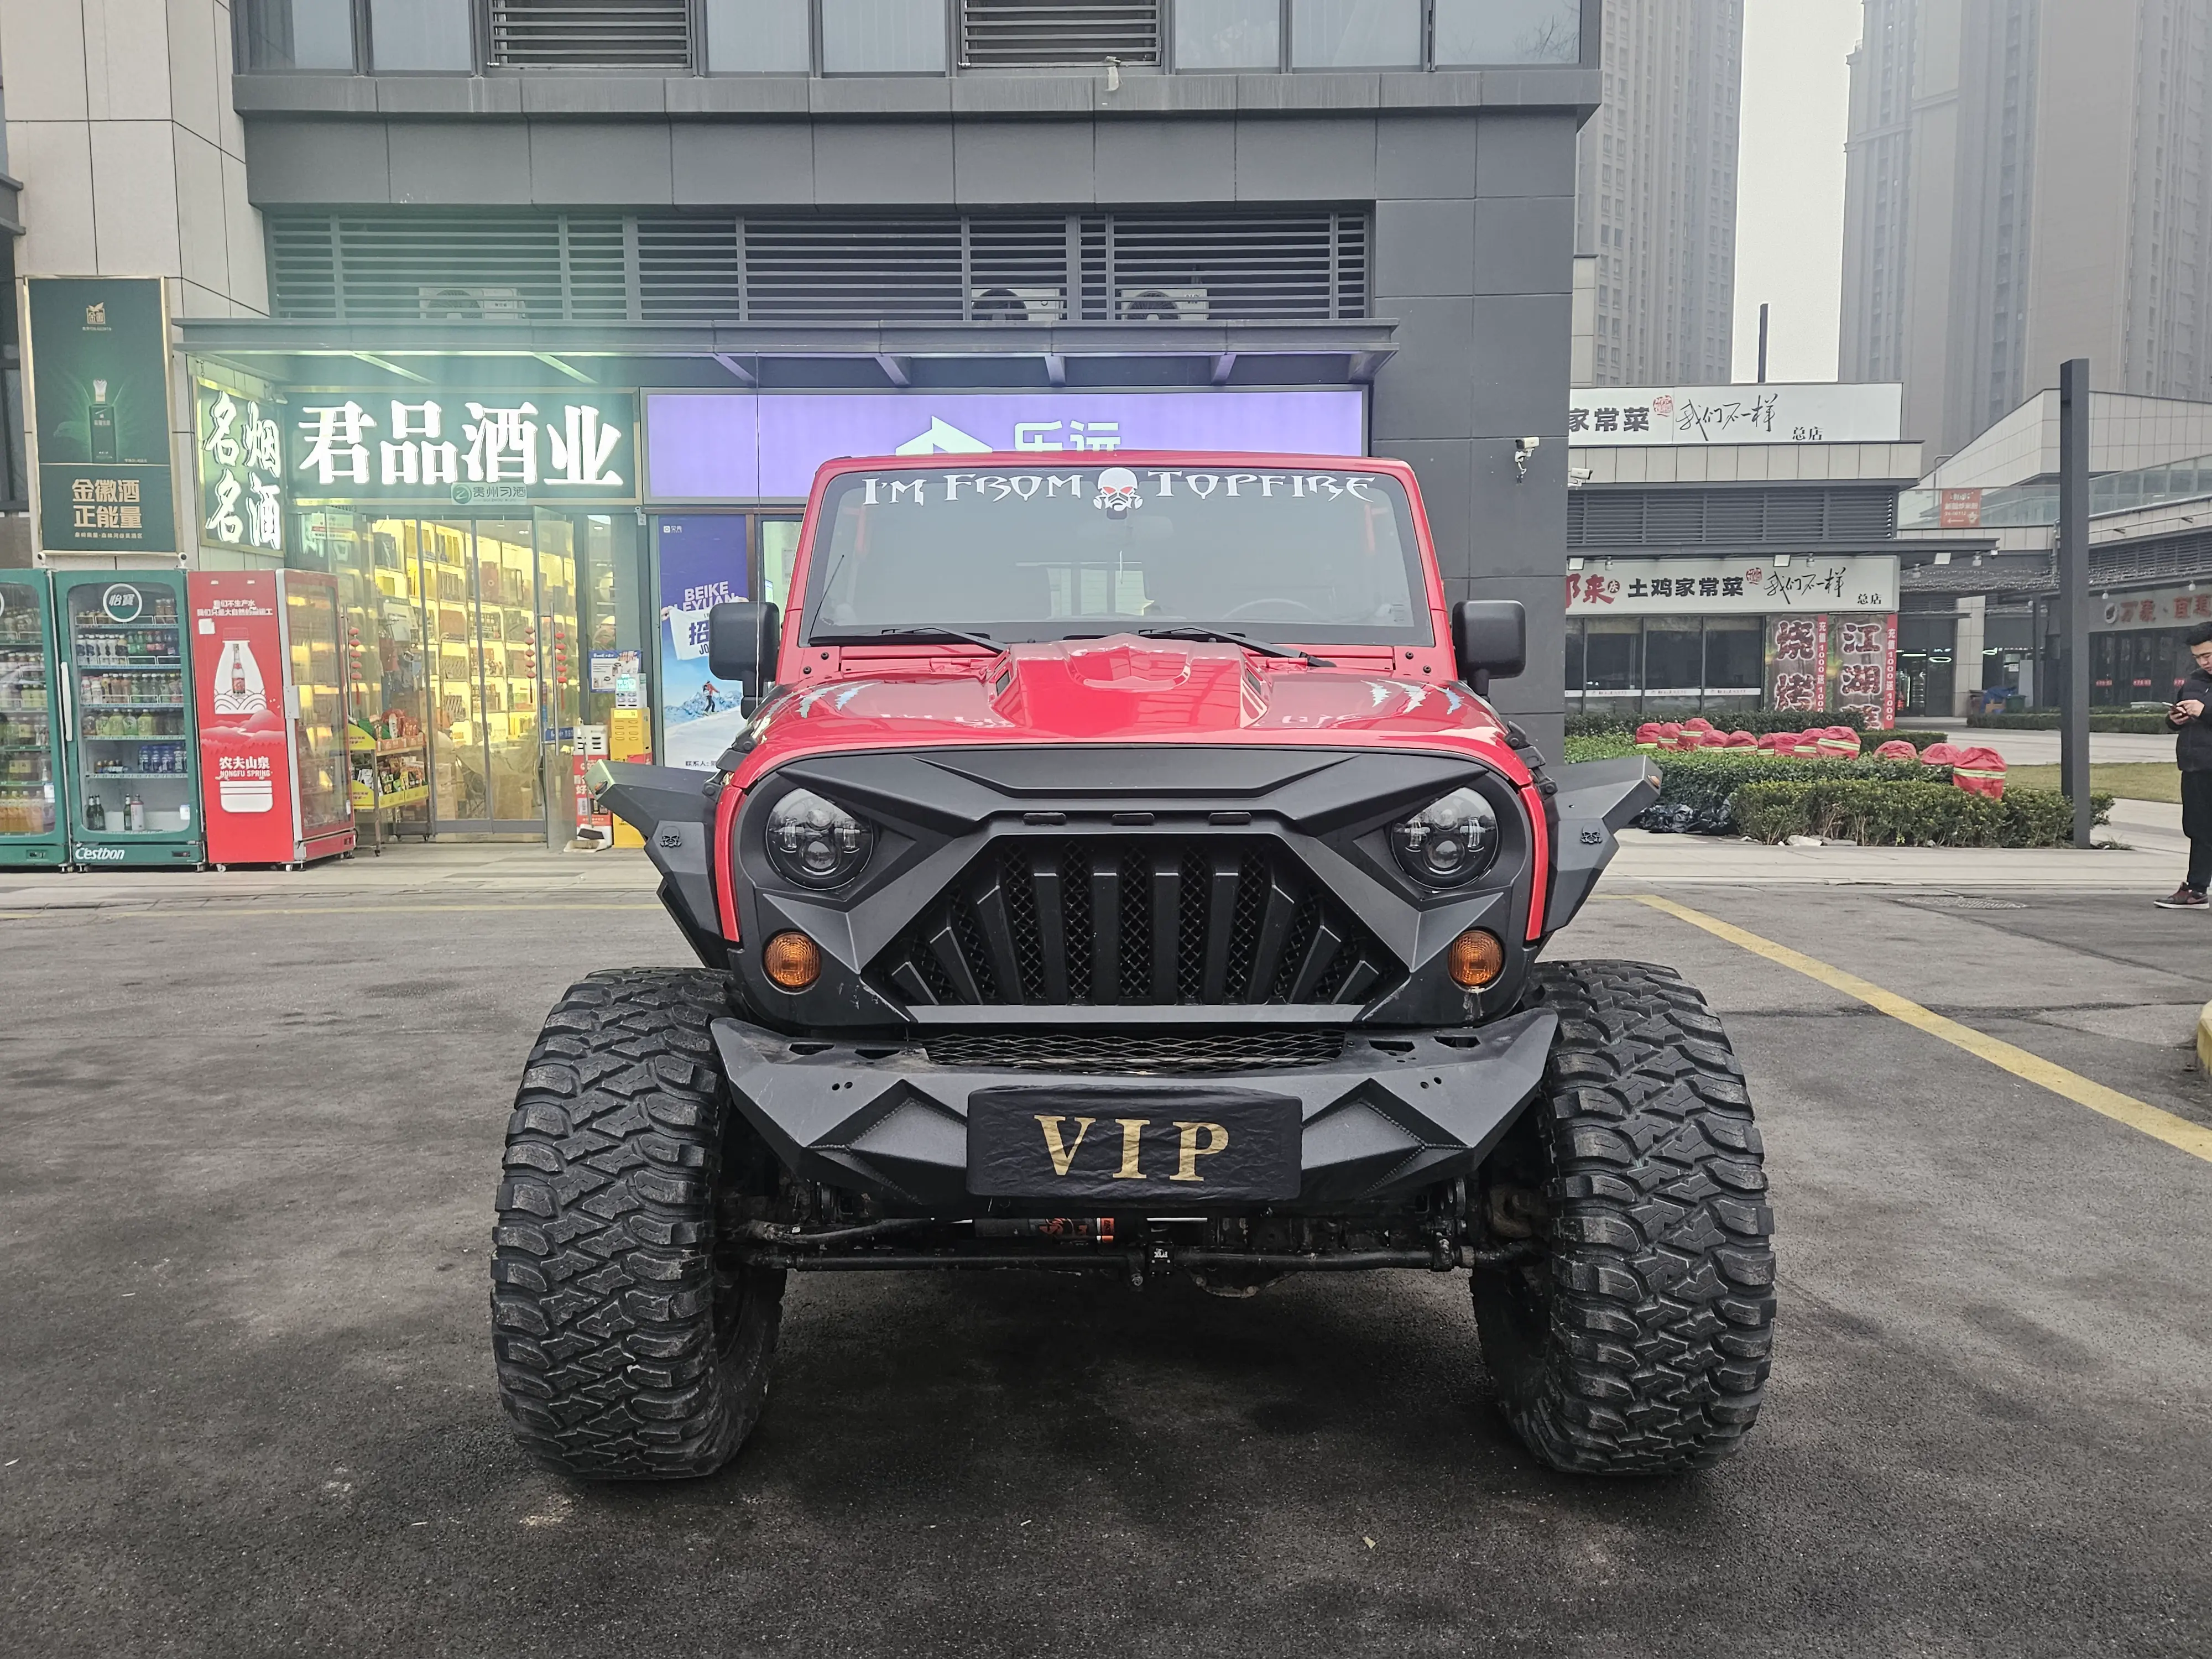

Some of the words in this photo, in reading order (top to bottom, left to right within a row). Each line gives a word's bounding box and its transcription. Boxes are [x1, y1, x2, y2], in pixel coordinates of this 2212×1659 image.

[1569, 407, 1650, 432] 家常菜
[1676, 393, 1778, 441] 我们不一样
[203, 390, 281, 478] 名烟
[299, 399, 624, 486] 君品酒业
[1792, 426, 1824, 441] 总店
[72, 479, 140, 503] 金徽酒
[473, 486, 526, 497] 贵州习酒
[943, 473, 1084, 502] FROM
[1147, 470, 1376, 502] TOPFIRE
[73, 505, 143, 529] 正能量
[685, 581, 728, 602] BEIKE
[1627, 576, 1744, 598] 土鸡家常菜
[1764, 567, 1846, 605] 我们不一样
[675, 592, 737, 612] EYUAN
[1858, 593, 1881, 604] 总店
[1776, 620, 1814, 712] 烧烤
[1886, 629, 1896, 721] 充值1000送1000
[219, 756, 270, 769] 农夫山泉
[1034, 1114, 1229, 1181] VIP
